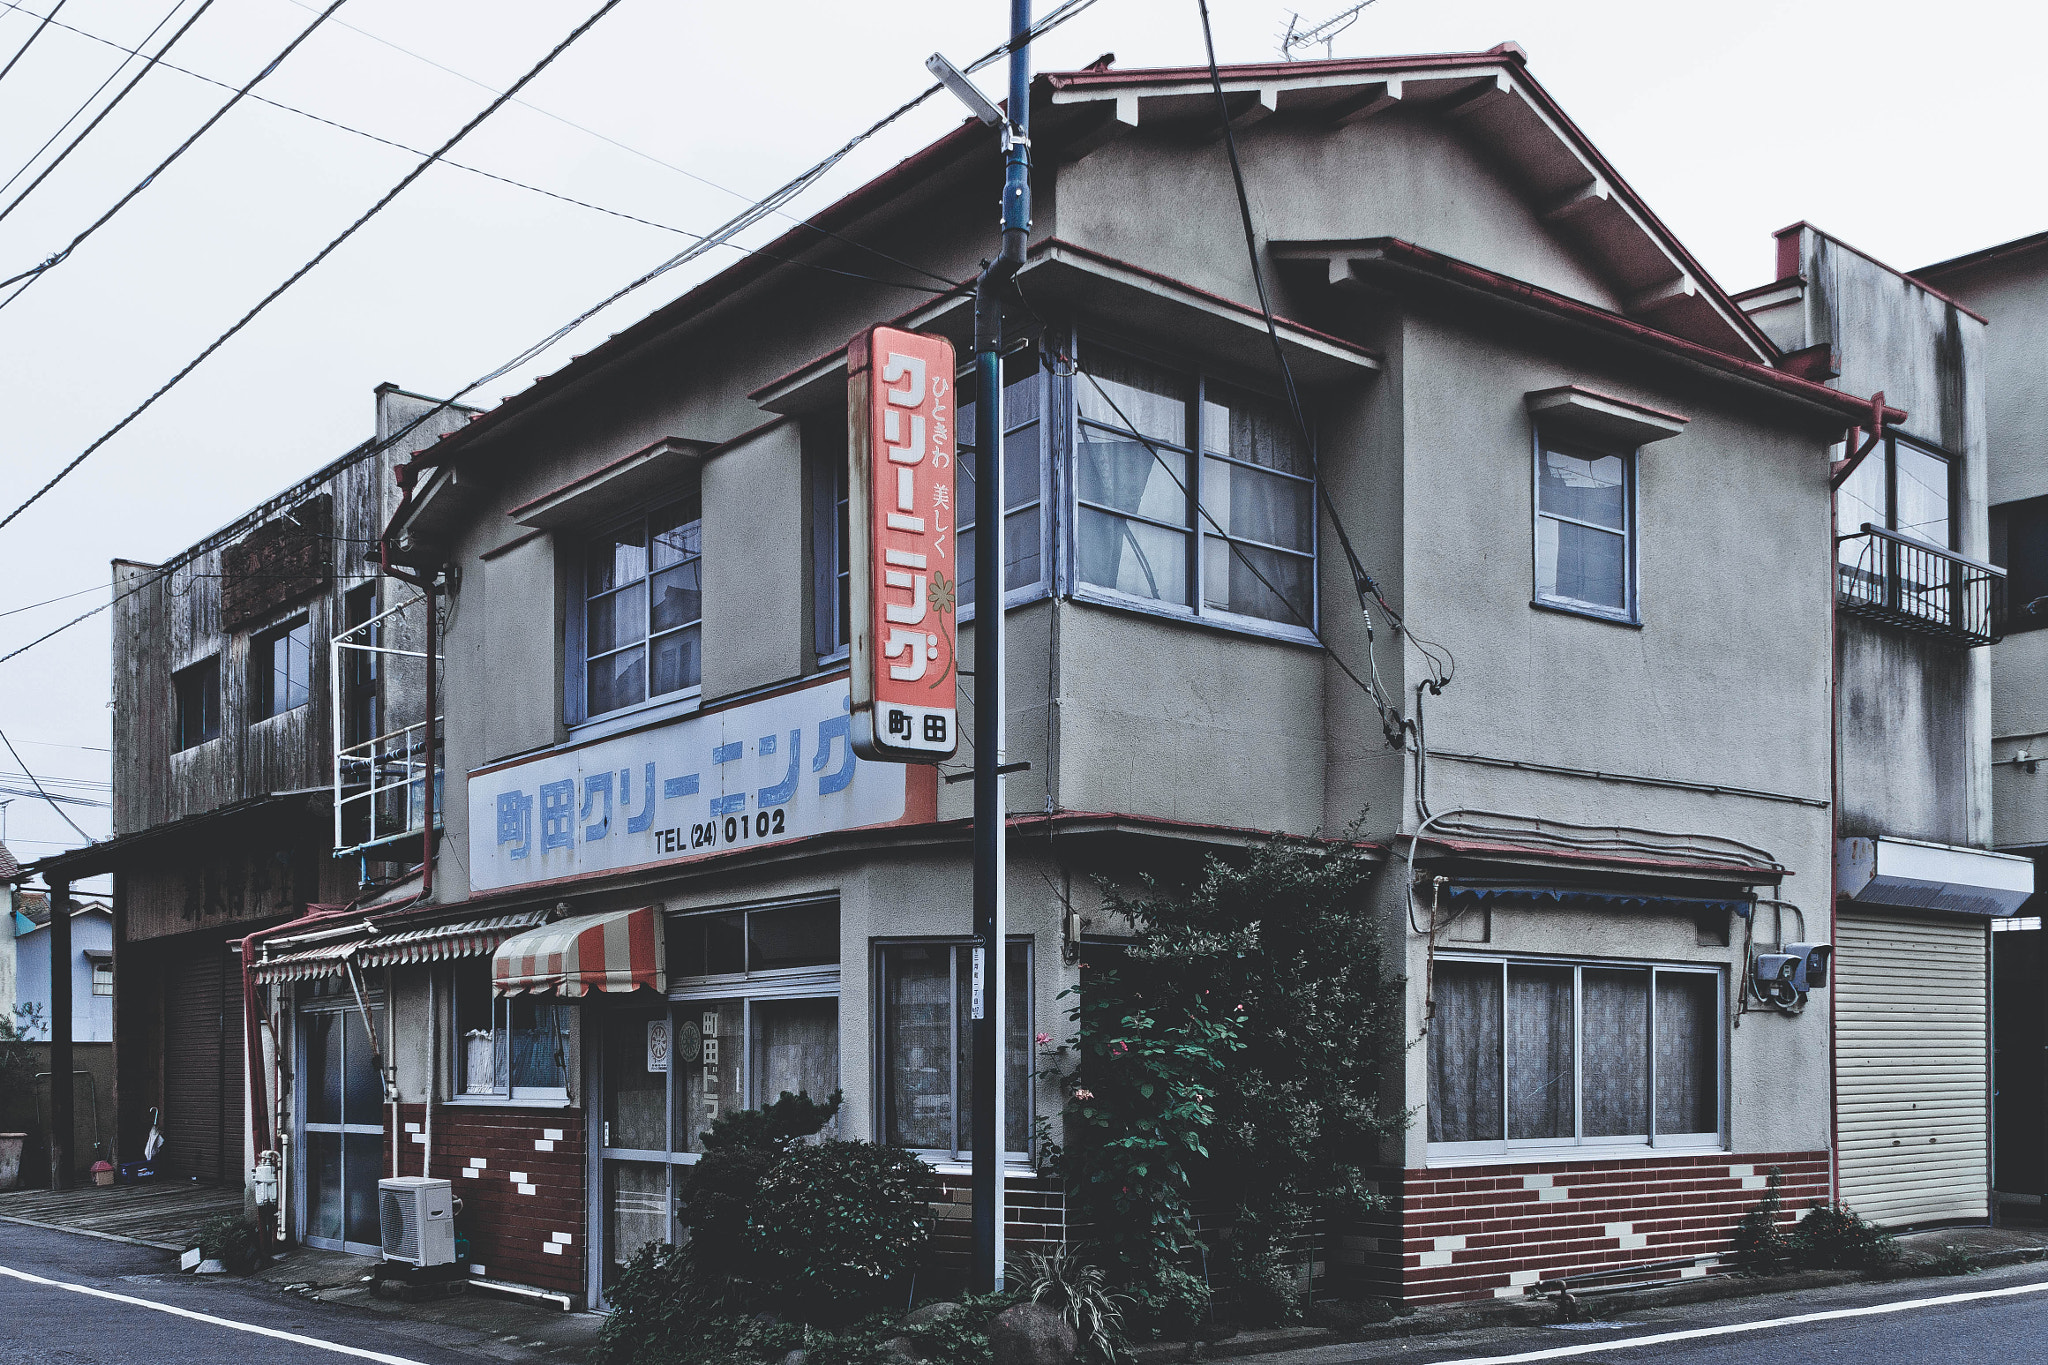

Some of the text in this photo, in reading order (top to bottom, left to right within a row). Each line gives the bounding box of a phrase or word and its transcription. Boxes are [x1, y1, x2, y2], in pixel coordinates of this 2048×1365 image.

[883, 353, 937, 682] クリーニング
[931, 376, 950, 558] ひときわ 美しく
[497, 695, 857, 861] 町田クリーニング
[888, 708, 947, 742] 町田
[655, 827, 687, 854] TEL
[725, 809, 785, 843] 0102
